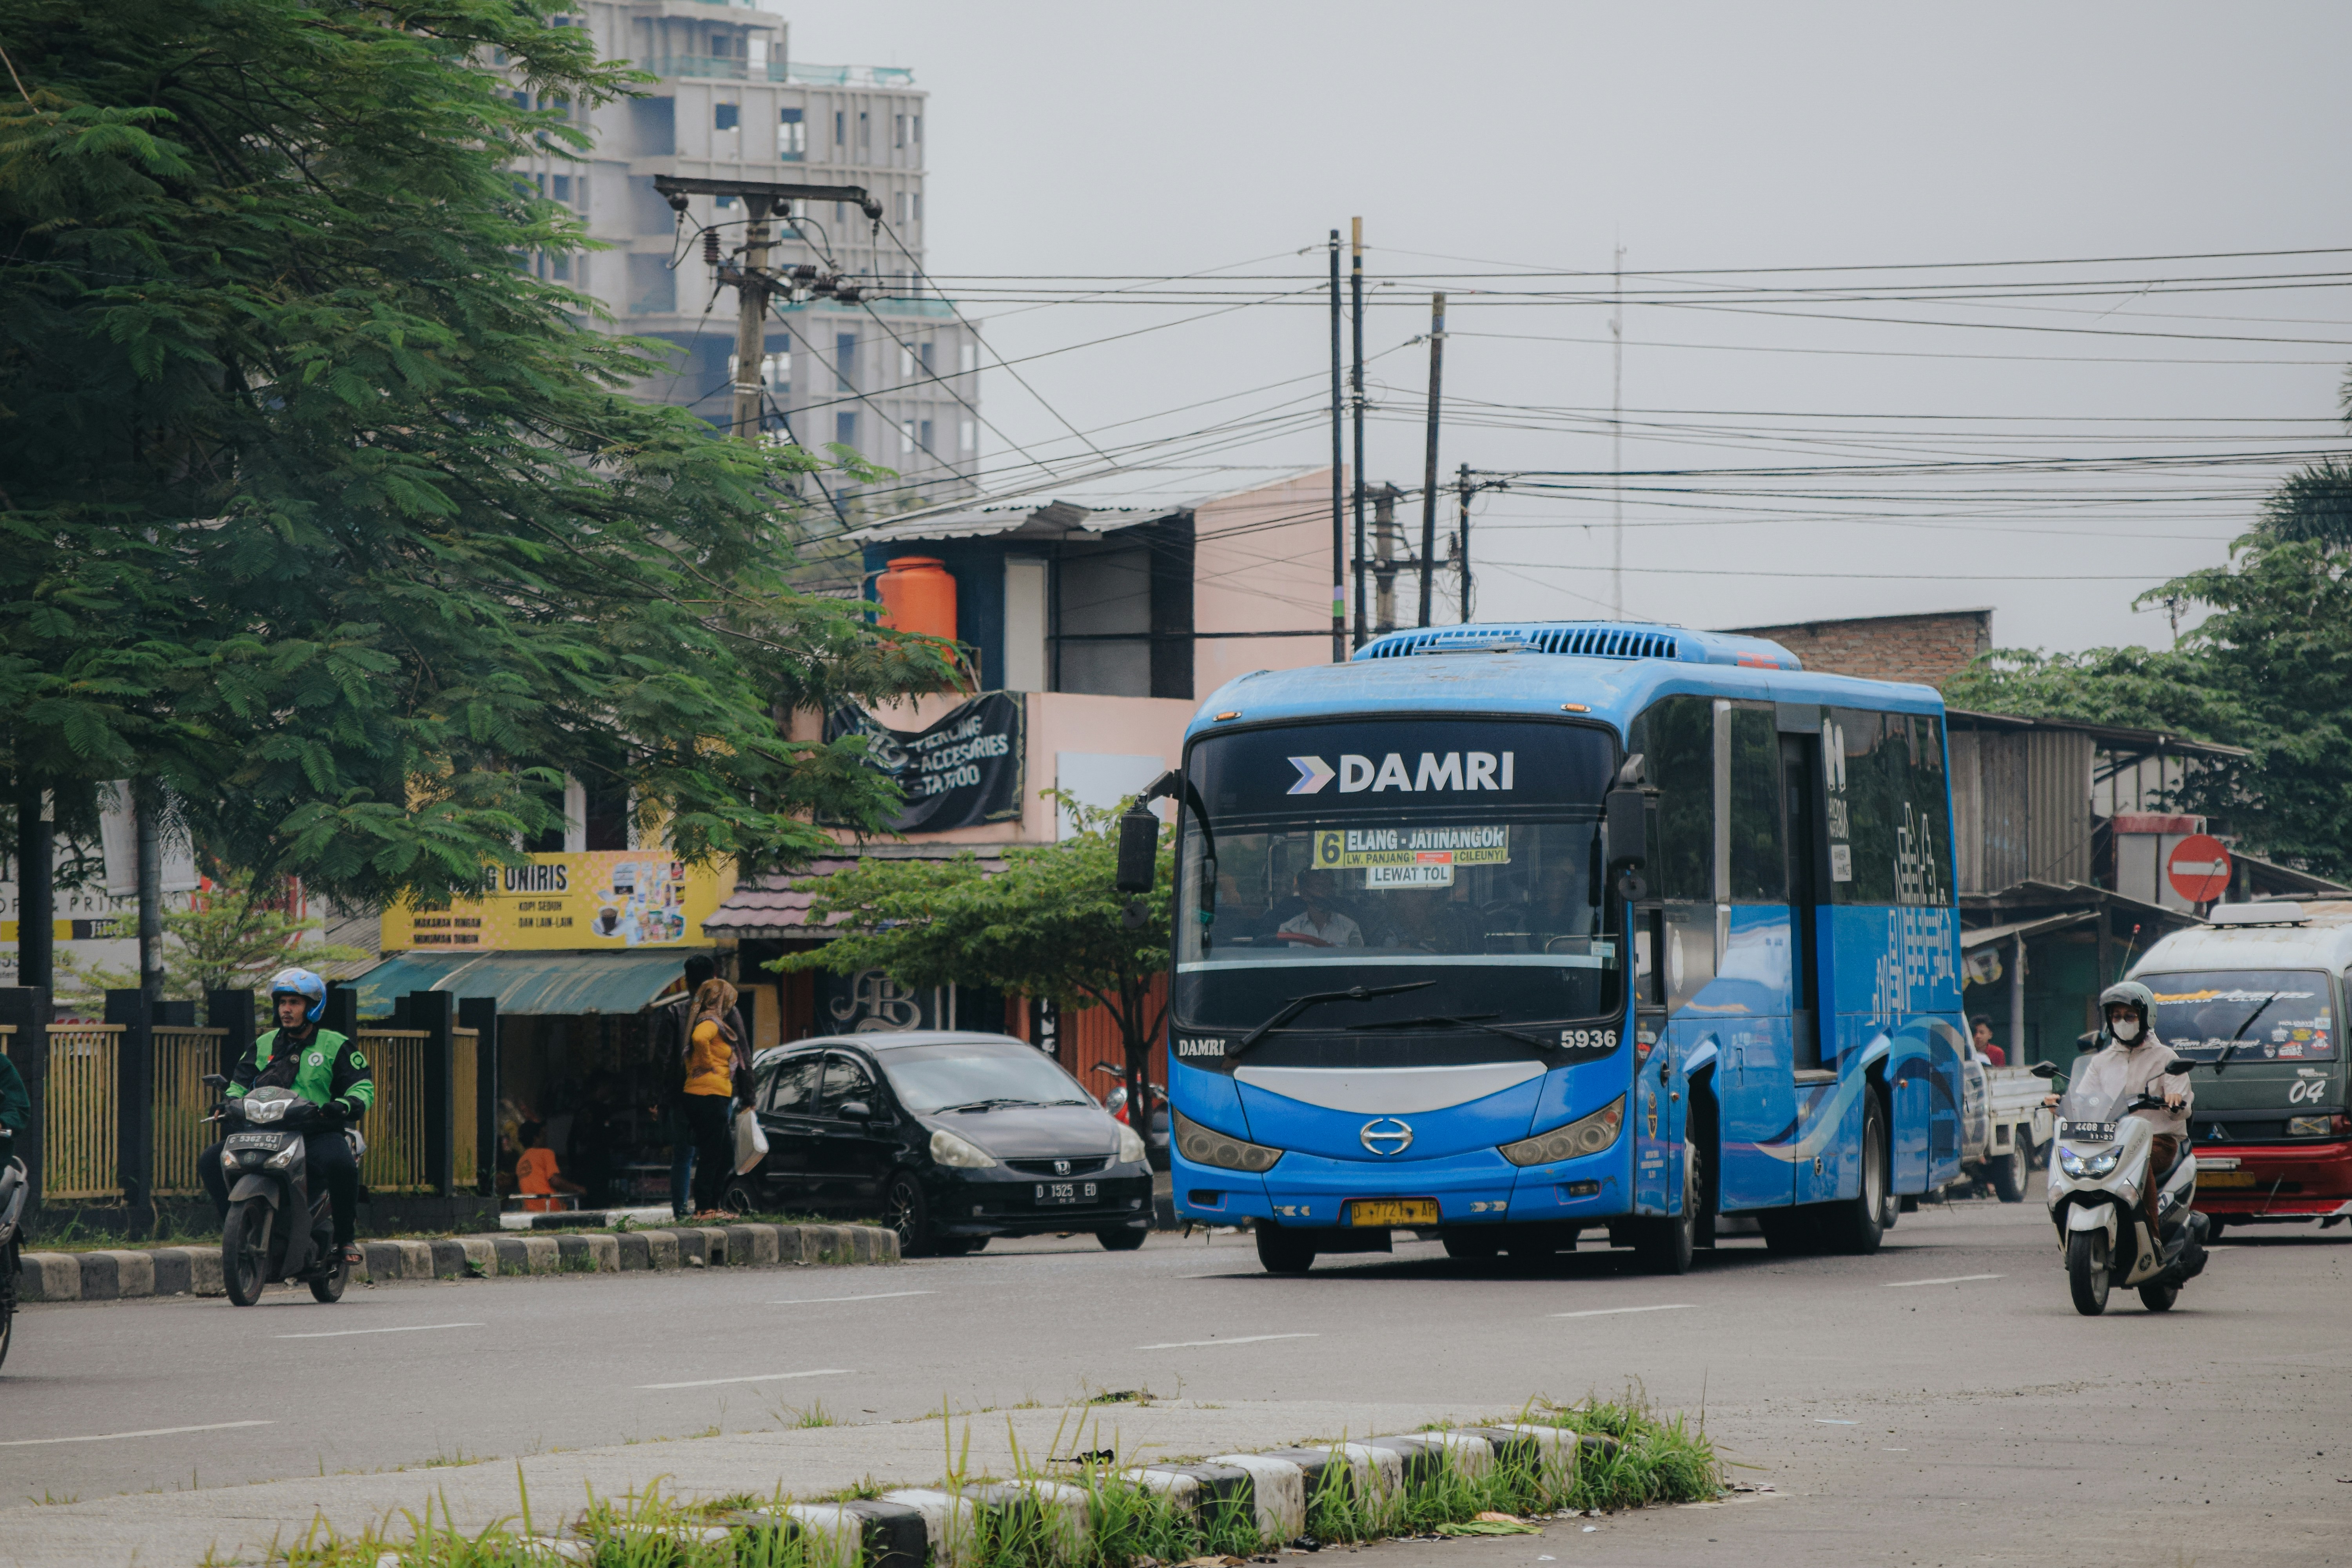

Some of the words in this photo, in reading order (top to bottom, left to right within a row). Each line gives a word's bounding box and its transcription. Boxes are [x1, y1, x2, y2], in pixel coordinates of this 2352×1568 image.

[1339, 751, 1514, 793] DAMRI
[1321, 833, 1341, 864] 6
[1348, 829, 1398, 851] ELANG
[1347, 854, 1363, 865] LW.
[1366, 852, 1410, 864] PANJANG
[1459, 849, 1503, 862] CILEUNYI
[1374, 867, 1418, 882] LEWAT
[1423, 866, 1448, 880] TOL
[1179, 1039, 1226, 1056] DAMRI
[1561, 1030, 1617, 1048] 5936
[2289, 1080, 2326, 1104] 04
[2075, 1122, 2098, 1132] 4408
[1036, 1184, 1044, 1198] D
[1051, 1184, 1073, 1197] 1525
[1085, 1183, 1096, 1196] ED
[1374, 1201, 1403, 1218] 7721
[1421, 1201, 1436, 1217] AP
